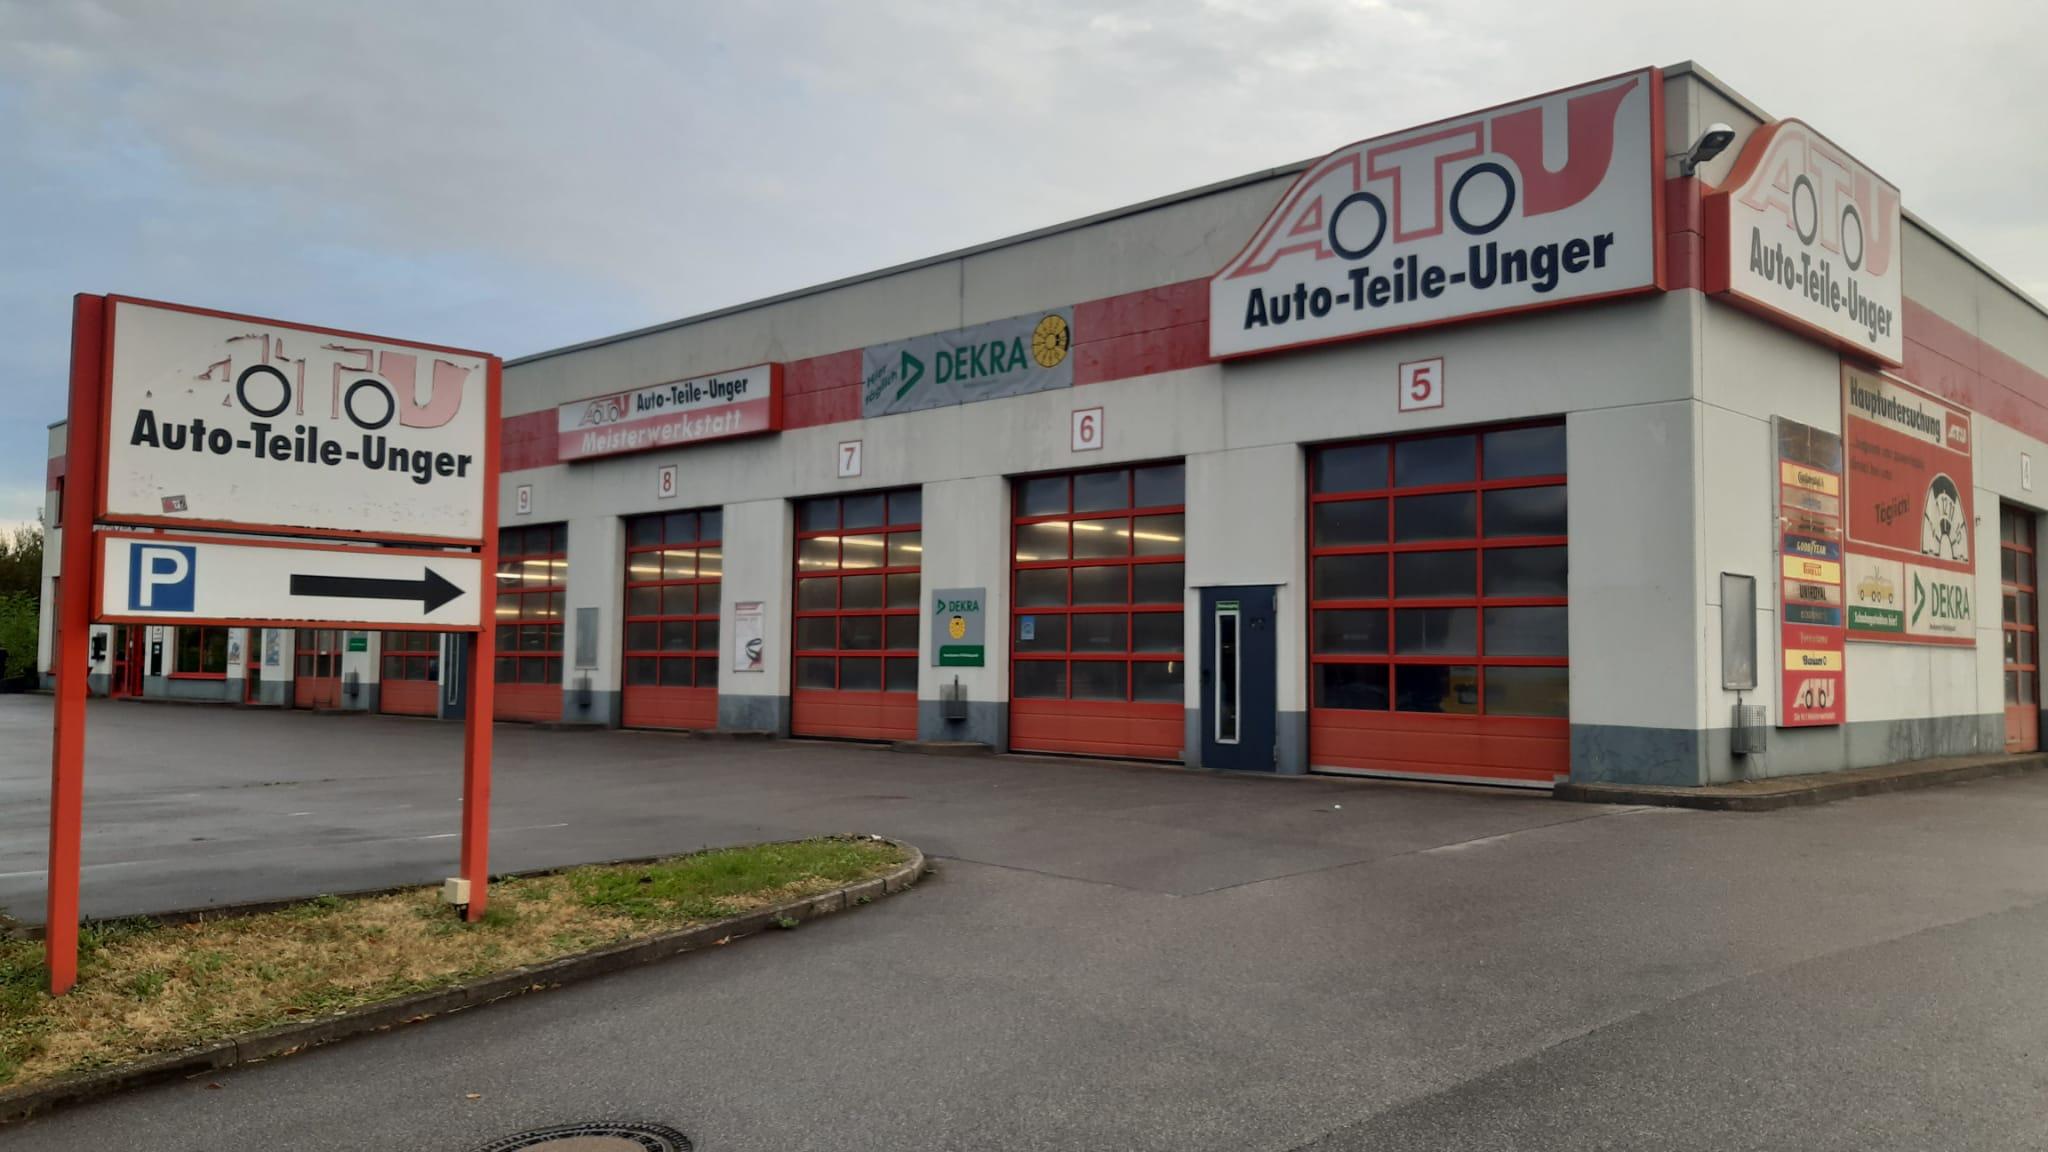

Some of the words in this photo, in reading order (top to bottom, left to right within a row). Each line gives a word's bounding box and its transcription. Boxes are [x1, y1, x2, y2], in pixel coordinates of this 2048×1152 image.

[1244, 232, 1614, 331] Auto-Teile-Unger
[1750, 226, 1892, 342] Auto-Teile-Unger
[936, 336, 1028, 384] DEKRA
[637, 378, 748, 413] Auto-Teile-Unger
[1411, 367, 1432, 401] 5
[1850, 376, 1941, 443] Hauptuntersuchung
[130, 409, 472, 485] Auto-Teile-Unger
[582, 409, 742, 454] Meisterwerkstatt
[1079, 415, 1094, 443] 6
[843, 447, 855, 471] 7
[519, 490, 529, 509] 9
[662, 472, 673, 492] 8
[140, 548, 189, 608] P
[948, 600, 980, 612] DEKRA
[1931, 582, 1970, 620] DEKRA
